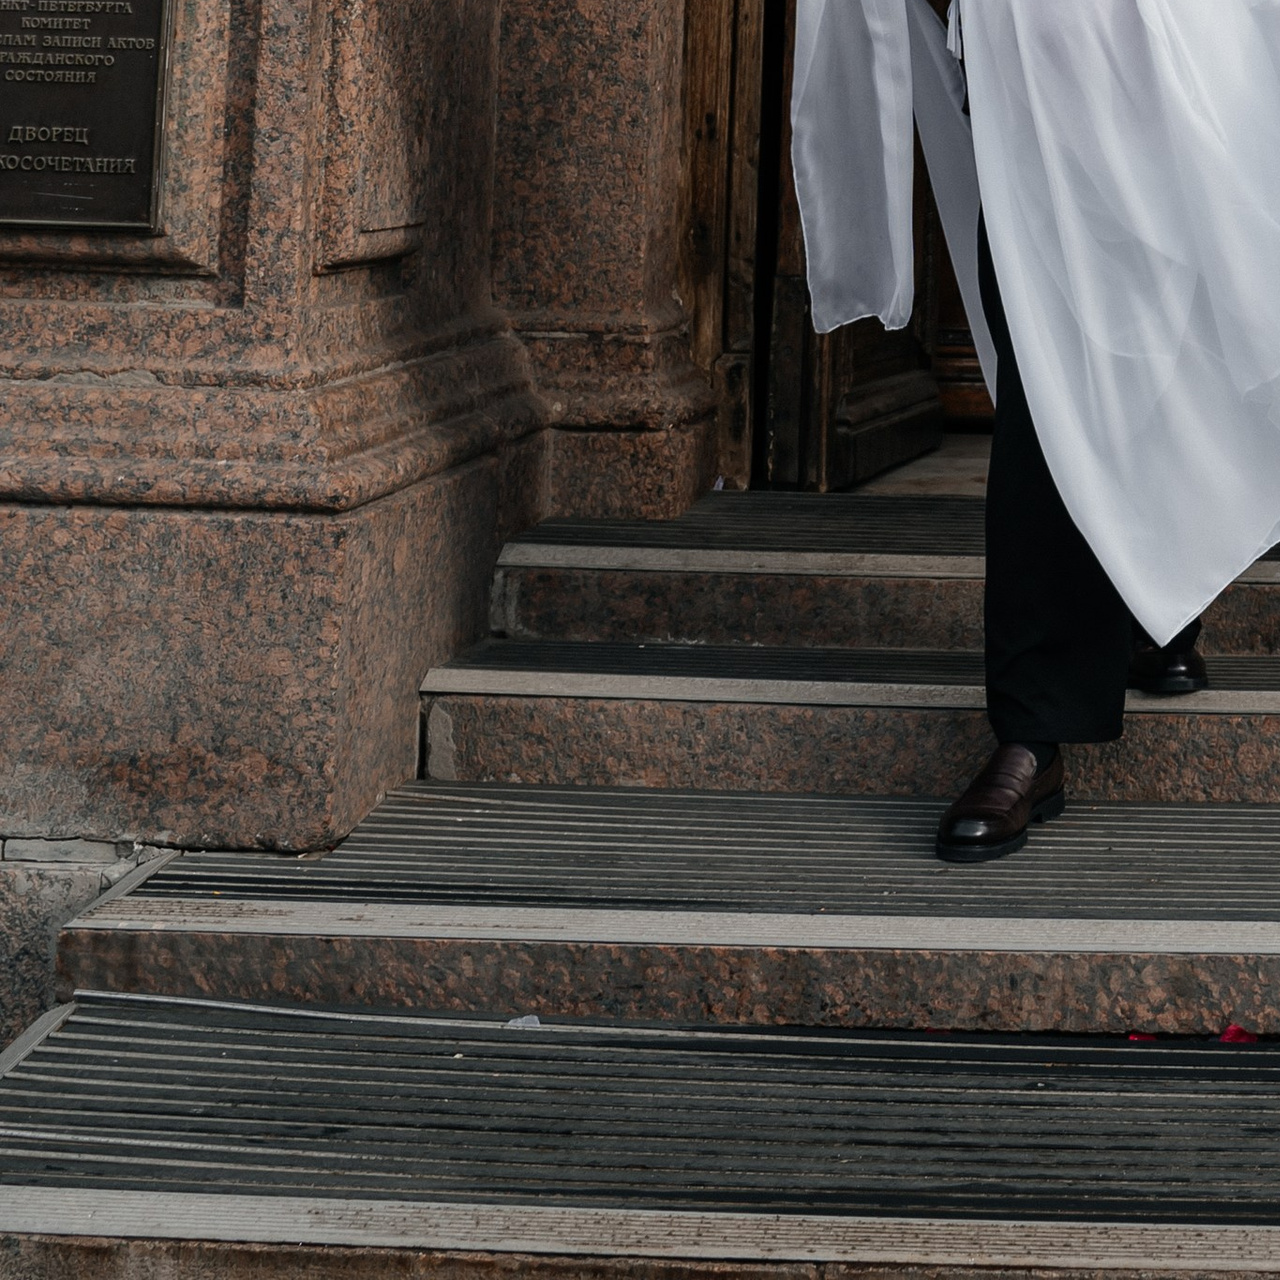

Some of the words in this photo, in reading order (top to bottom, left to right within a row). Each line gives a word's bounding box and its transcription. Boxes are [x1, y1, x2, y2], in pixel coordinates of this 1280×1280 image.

[21, 17, 91, 30] КОМИТЕТ
[42, 35, 102, 48] ЗАПИСИ
[107, 37, 155, 50] АКТОВ
[4, 69, 97, 83] СОСТОЯНИЯ
[7, 125, 89, 146] ДВОРЕЦ
